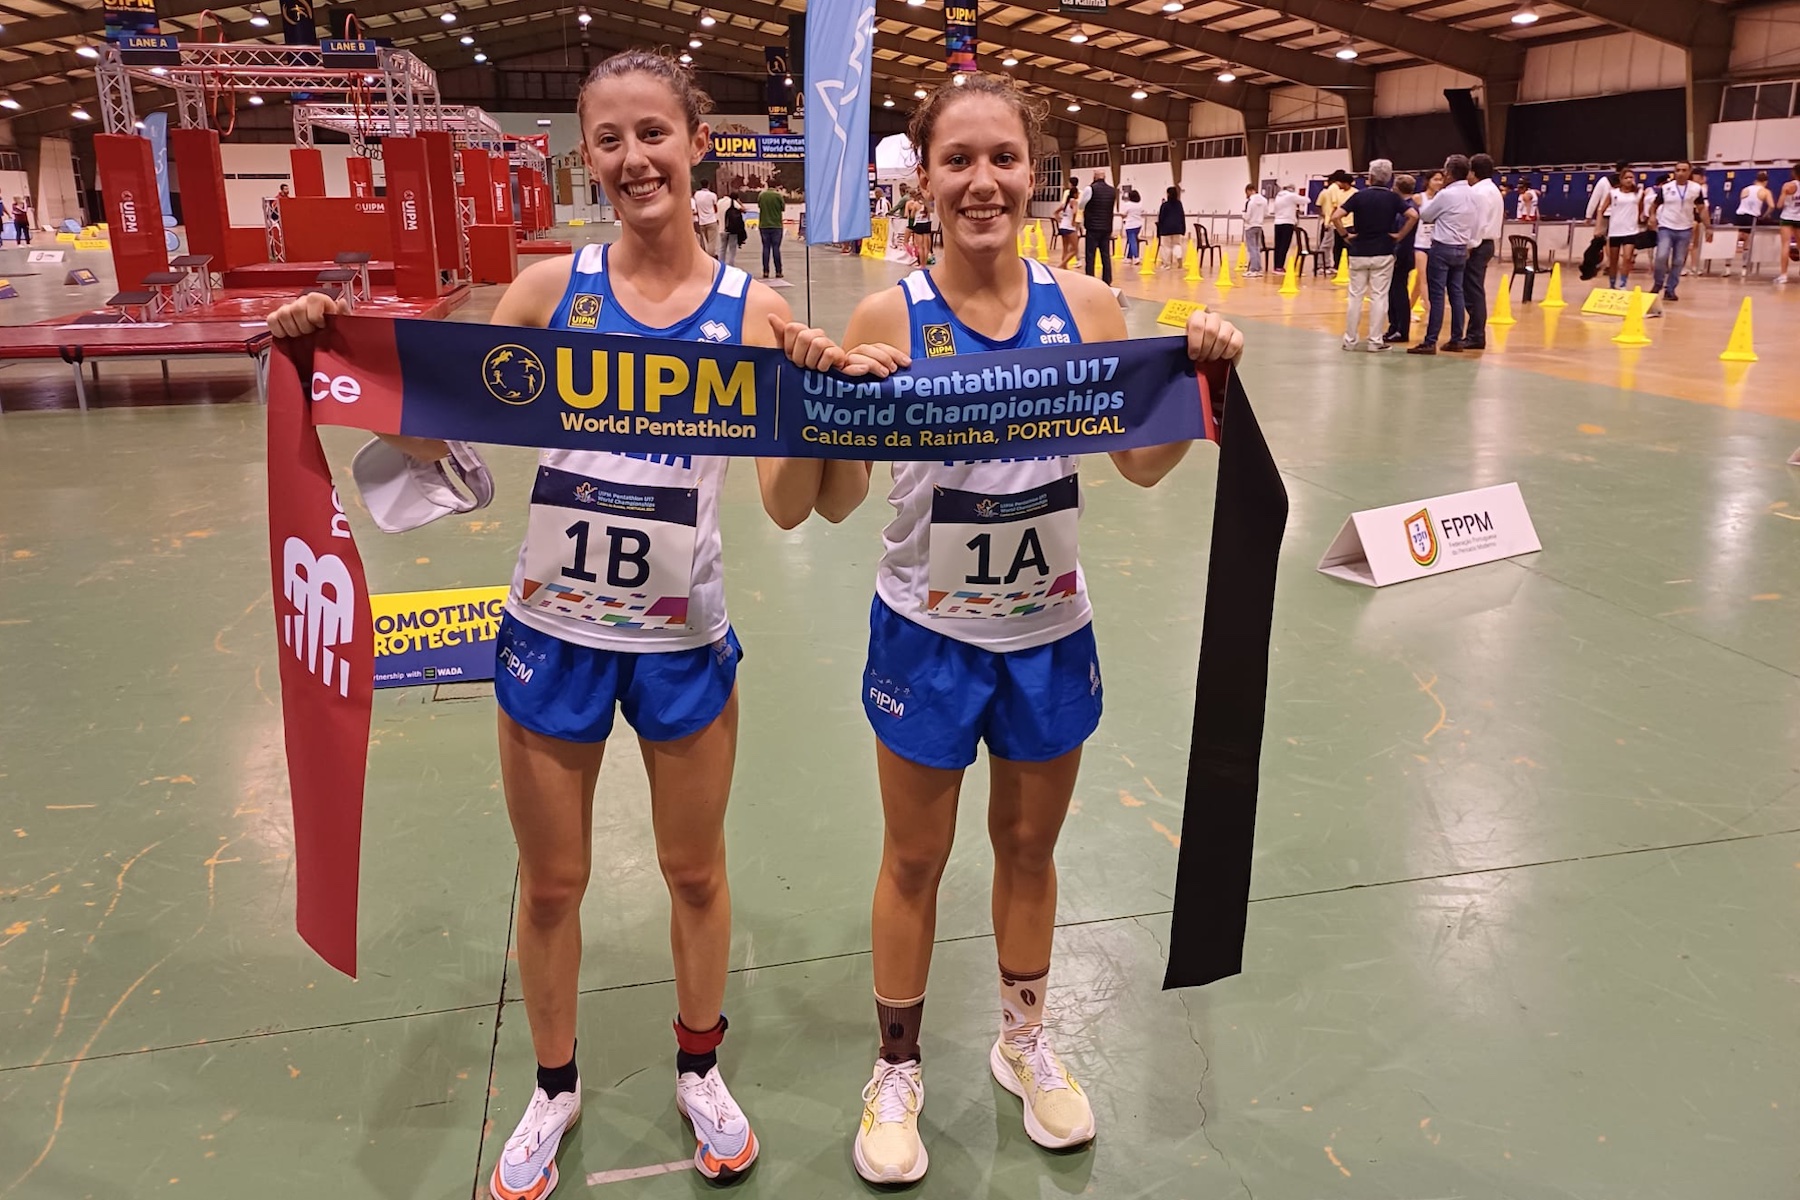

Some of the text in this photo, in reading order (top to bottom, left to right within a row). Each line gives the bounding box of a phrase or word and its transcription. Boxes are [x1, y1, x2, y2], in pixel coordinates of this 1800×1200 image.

[945, 7, 976, 21] UIPM
[129, 38, 168, 47] LANE A
[330, 42, 366, 51] LANE B
[714, 137, 757, 152] UIPM
[123, 201, 138, 232] UIPM
[362, 203, 385, 211] UIPM
[405, 200, 418, 230] UIPM
[571, 315, 596, 325] UIPM
[928, 345, 953, 356] UIPM
[1040, 333, 1071, 344] errea
[556, 347, 757, 416] UIPM
[803, 357, 1120, 399] UIPM Pentathlon U17
[803, 390, 1125, 426] World Championships
[560, 411, 757, 439] World Pentathlon
[802, 416, 1125, 447] Caldas da Rainha, PORTUGAL
[1441, 511, 1494, 540] FPPM
[561, 520, 651, 588] 1B
[965, 527, 1050, 585] 1A
[406, 670, 422, 679] with
[437, 667, 463, 676] WADA
[500, 646, 534, 683] FIPM
[870, 687, 904, 716] FIPM
